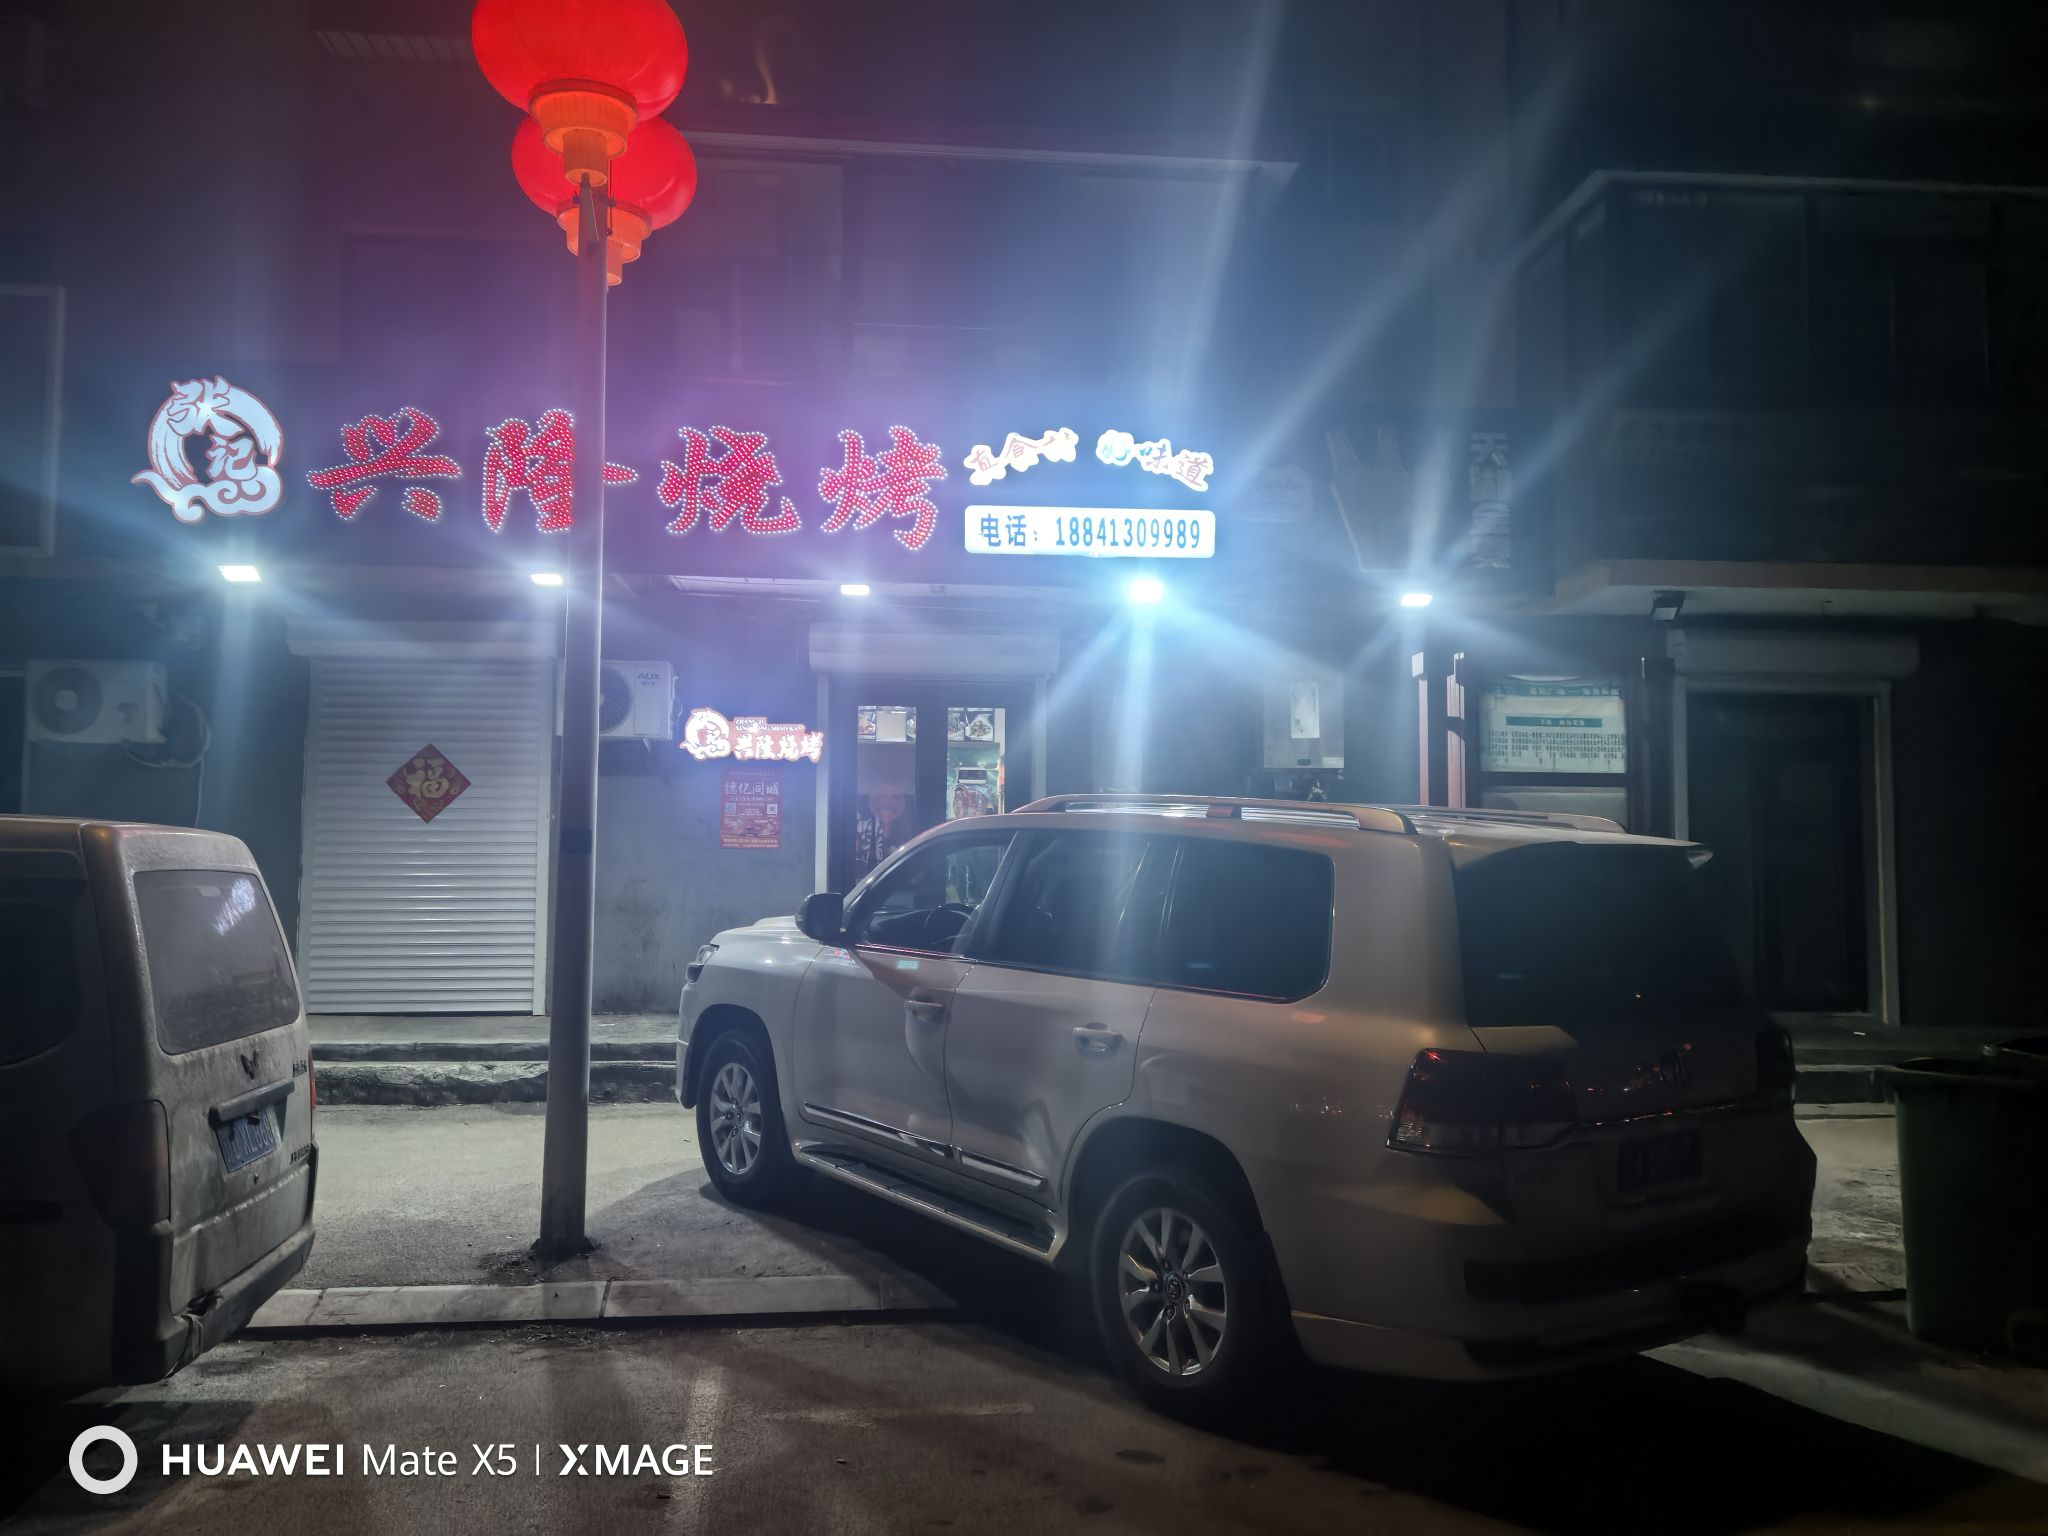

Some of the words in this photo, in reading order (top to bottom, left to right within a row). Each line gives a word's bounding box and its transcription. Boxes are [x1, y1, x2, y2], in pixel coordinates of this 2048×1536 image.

[306, 406, 948, 551] 兴隆烧烤
[1056, 516, 1201, 549] 18841309989
[406, 758, 450, 808] 福
